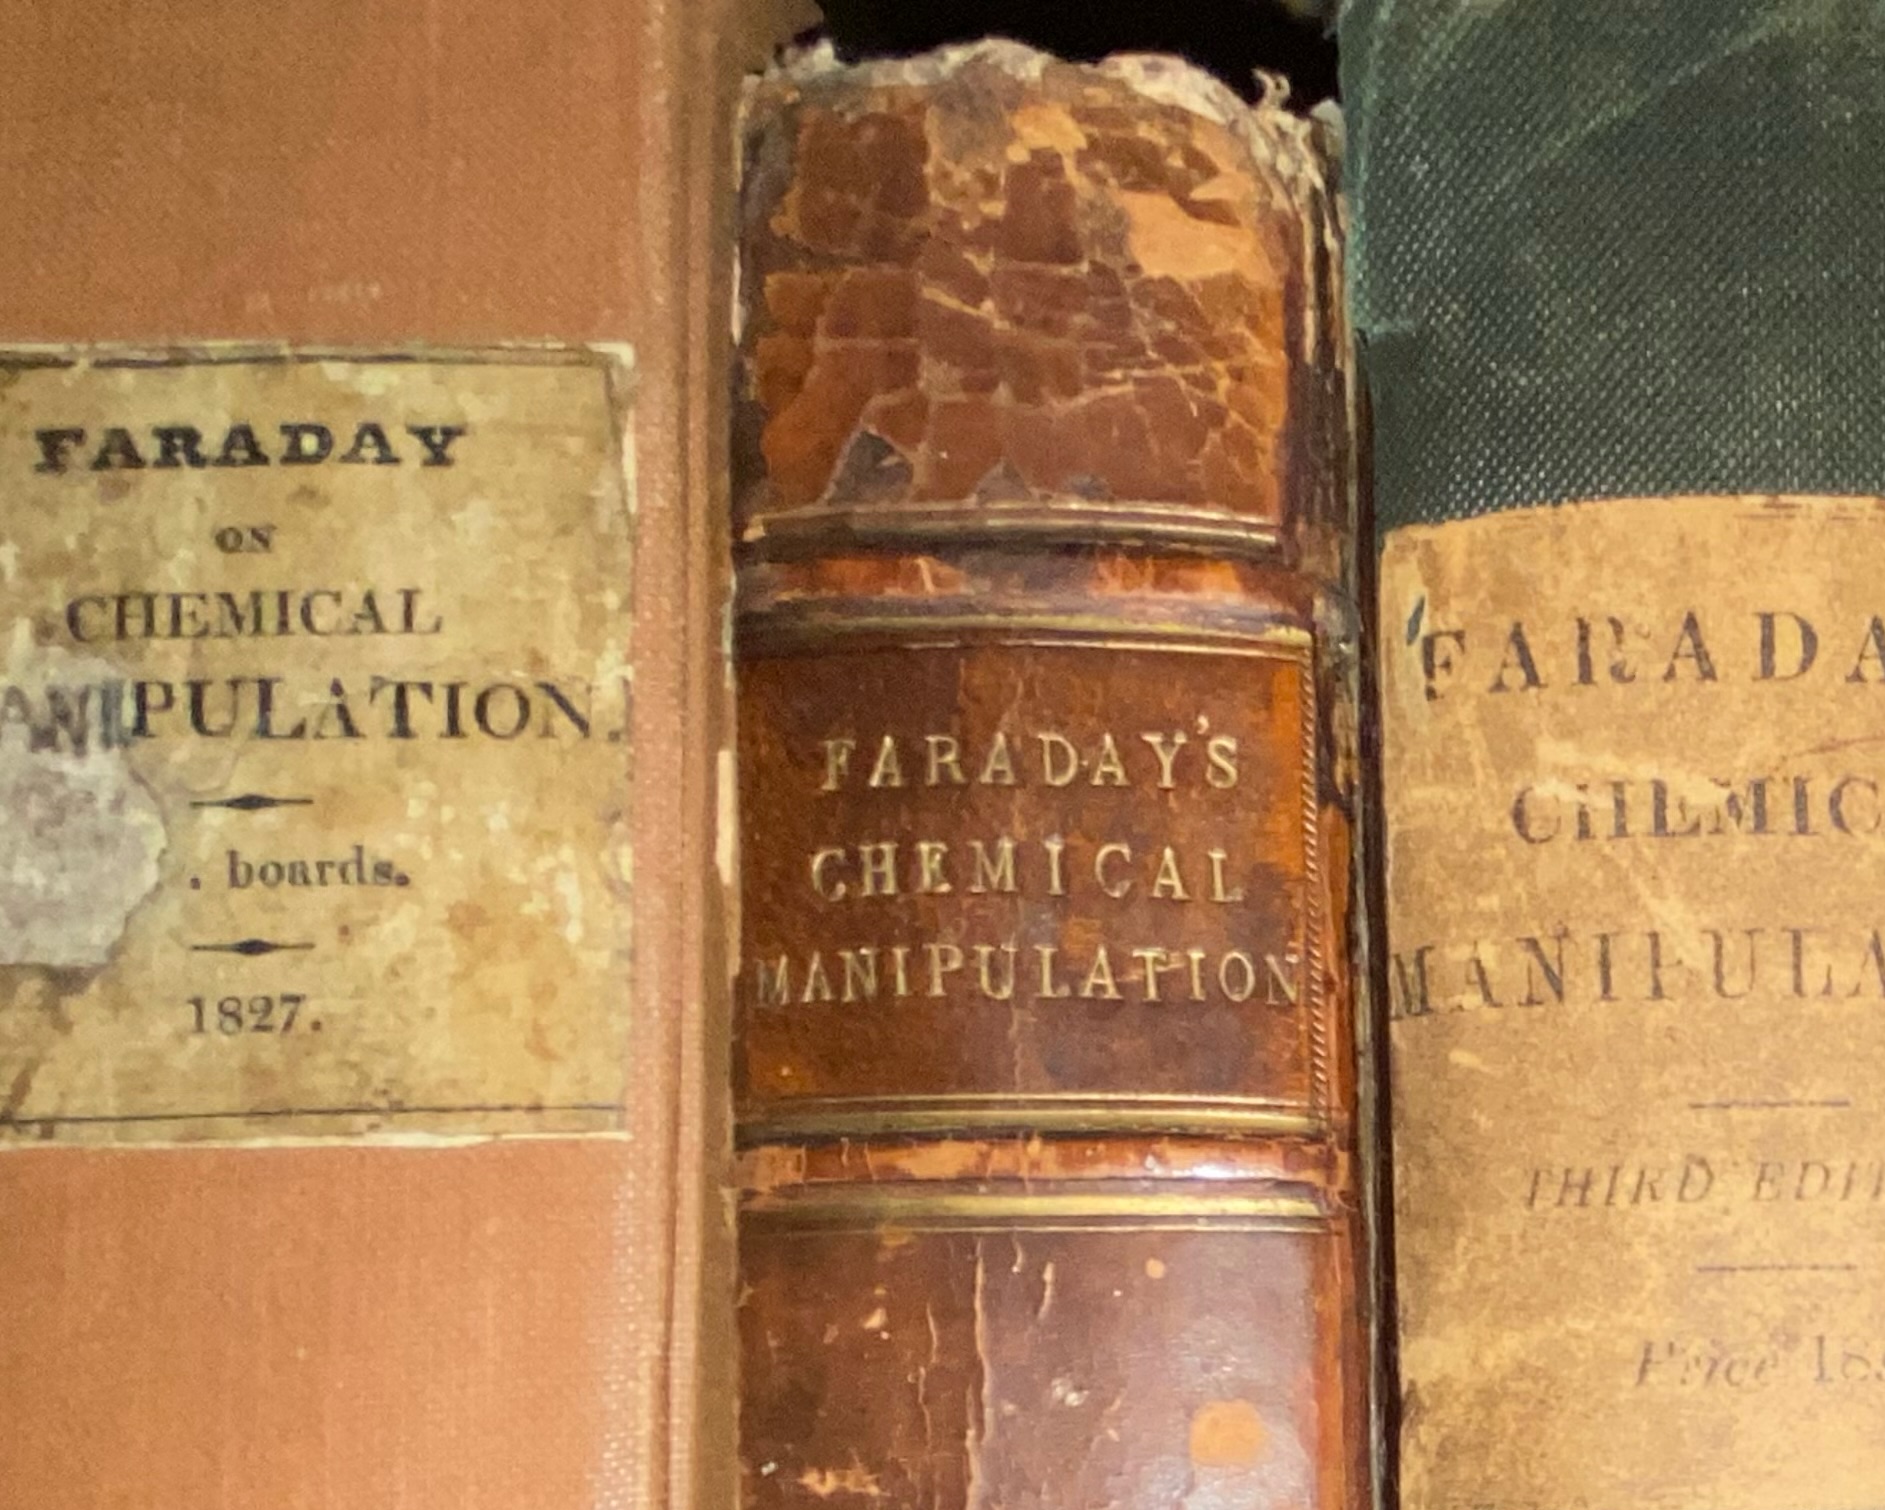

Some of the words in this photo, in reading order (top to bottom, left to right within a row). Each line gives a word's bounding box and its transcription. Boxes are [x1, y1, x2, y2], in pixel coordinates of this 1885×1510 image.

[34, 423, 467, 473] FARADAY
[214, 526, 275, 553] ON
[66, 589, 443, 644] CHEMICAL
[819, 715, 1240, 792] FARADAY'S
[227, 847, 410, 889] boards.
[810, 834, 1243, 902] CHEMICAL
[755, 943, 1300, 1007] MANIPULATION
[189, 996, 322, 1035] 1827.
[1521, 1155, 1717, 1211] THIRD
